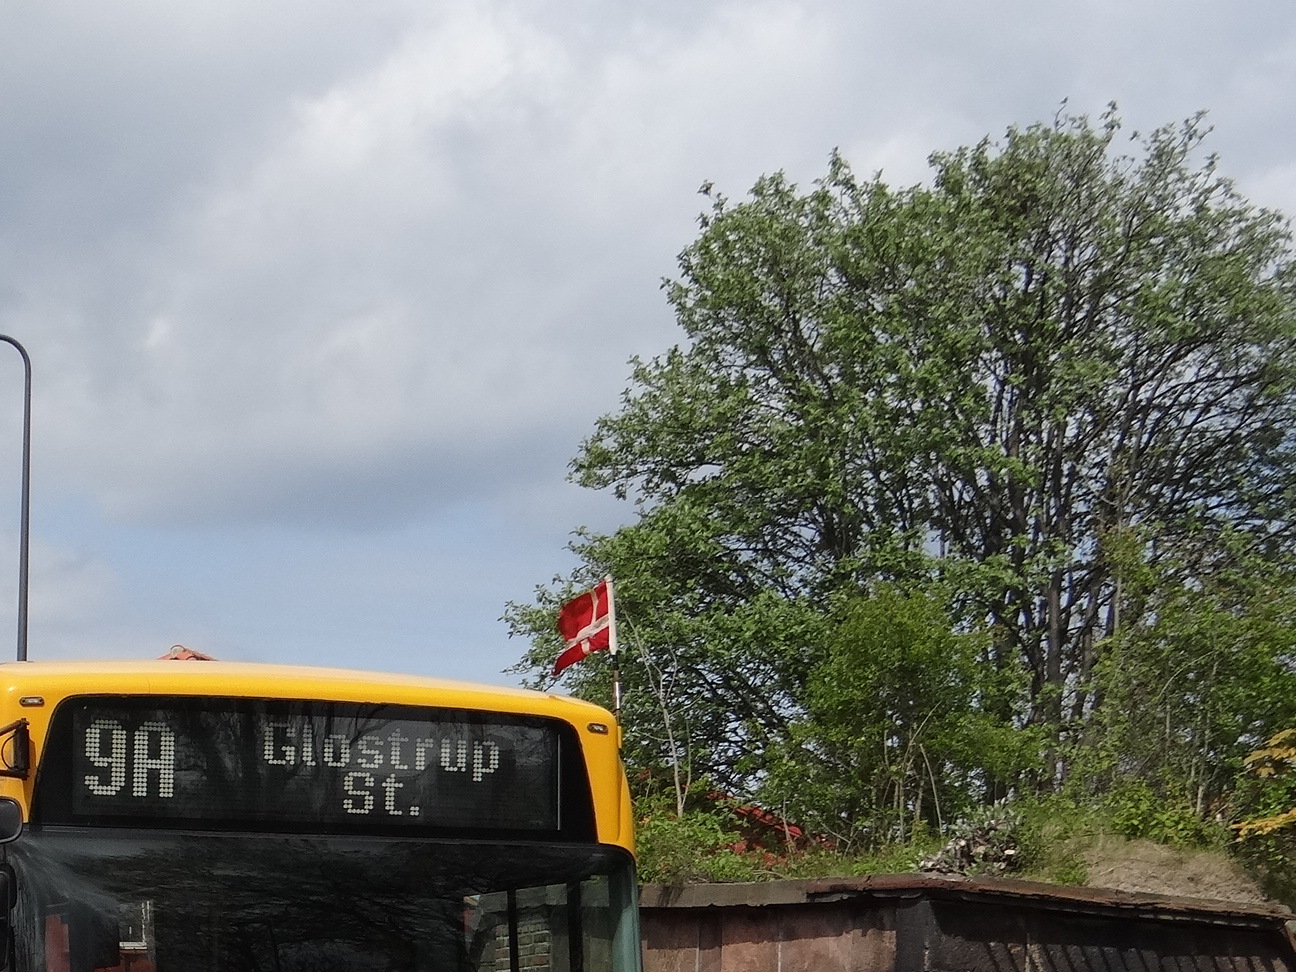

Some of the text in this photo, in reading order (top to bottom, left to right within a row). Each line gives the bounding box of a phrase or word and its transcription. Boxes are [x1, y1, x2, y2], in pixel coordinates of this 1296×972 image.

[85, 719, 175, 798] 9A
[264, 722, 499, 782] Glostrup
[343, 772, 421, 816] St.
